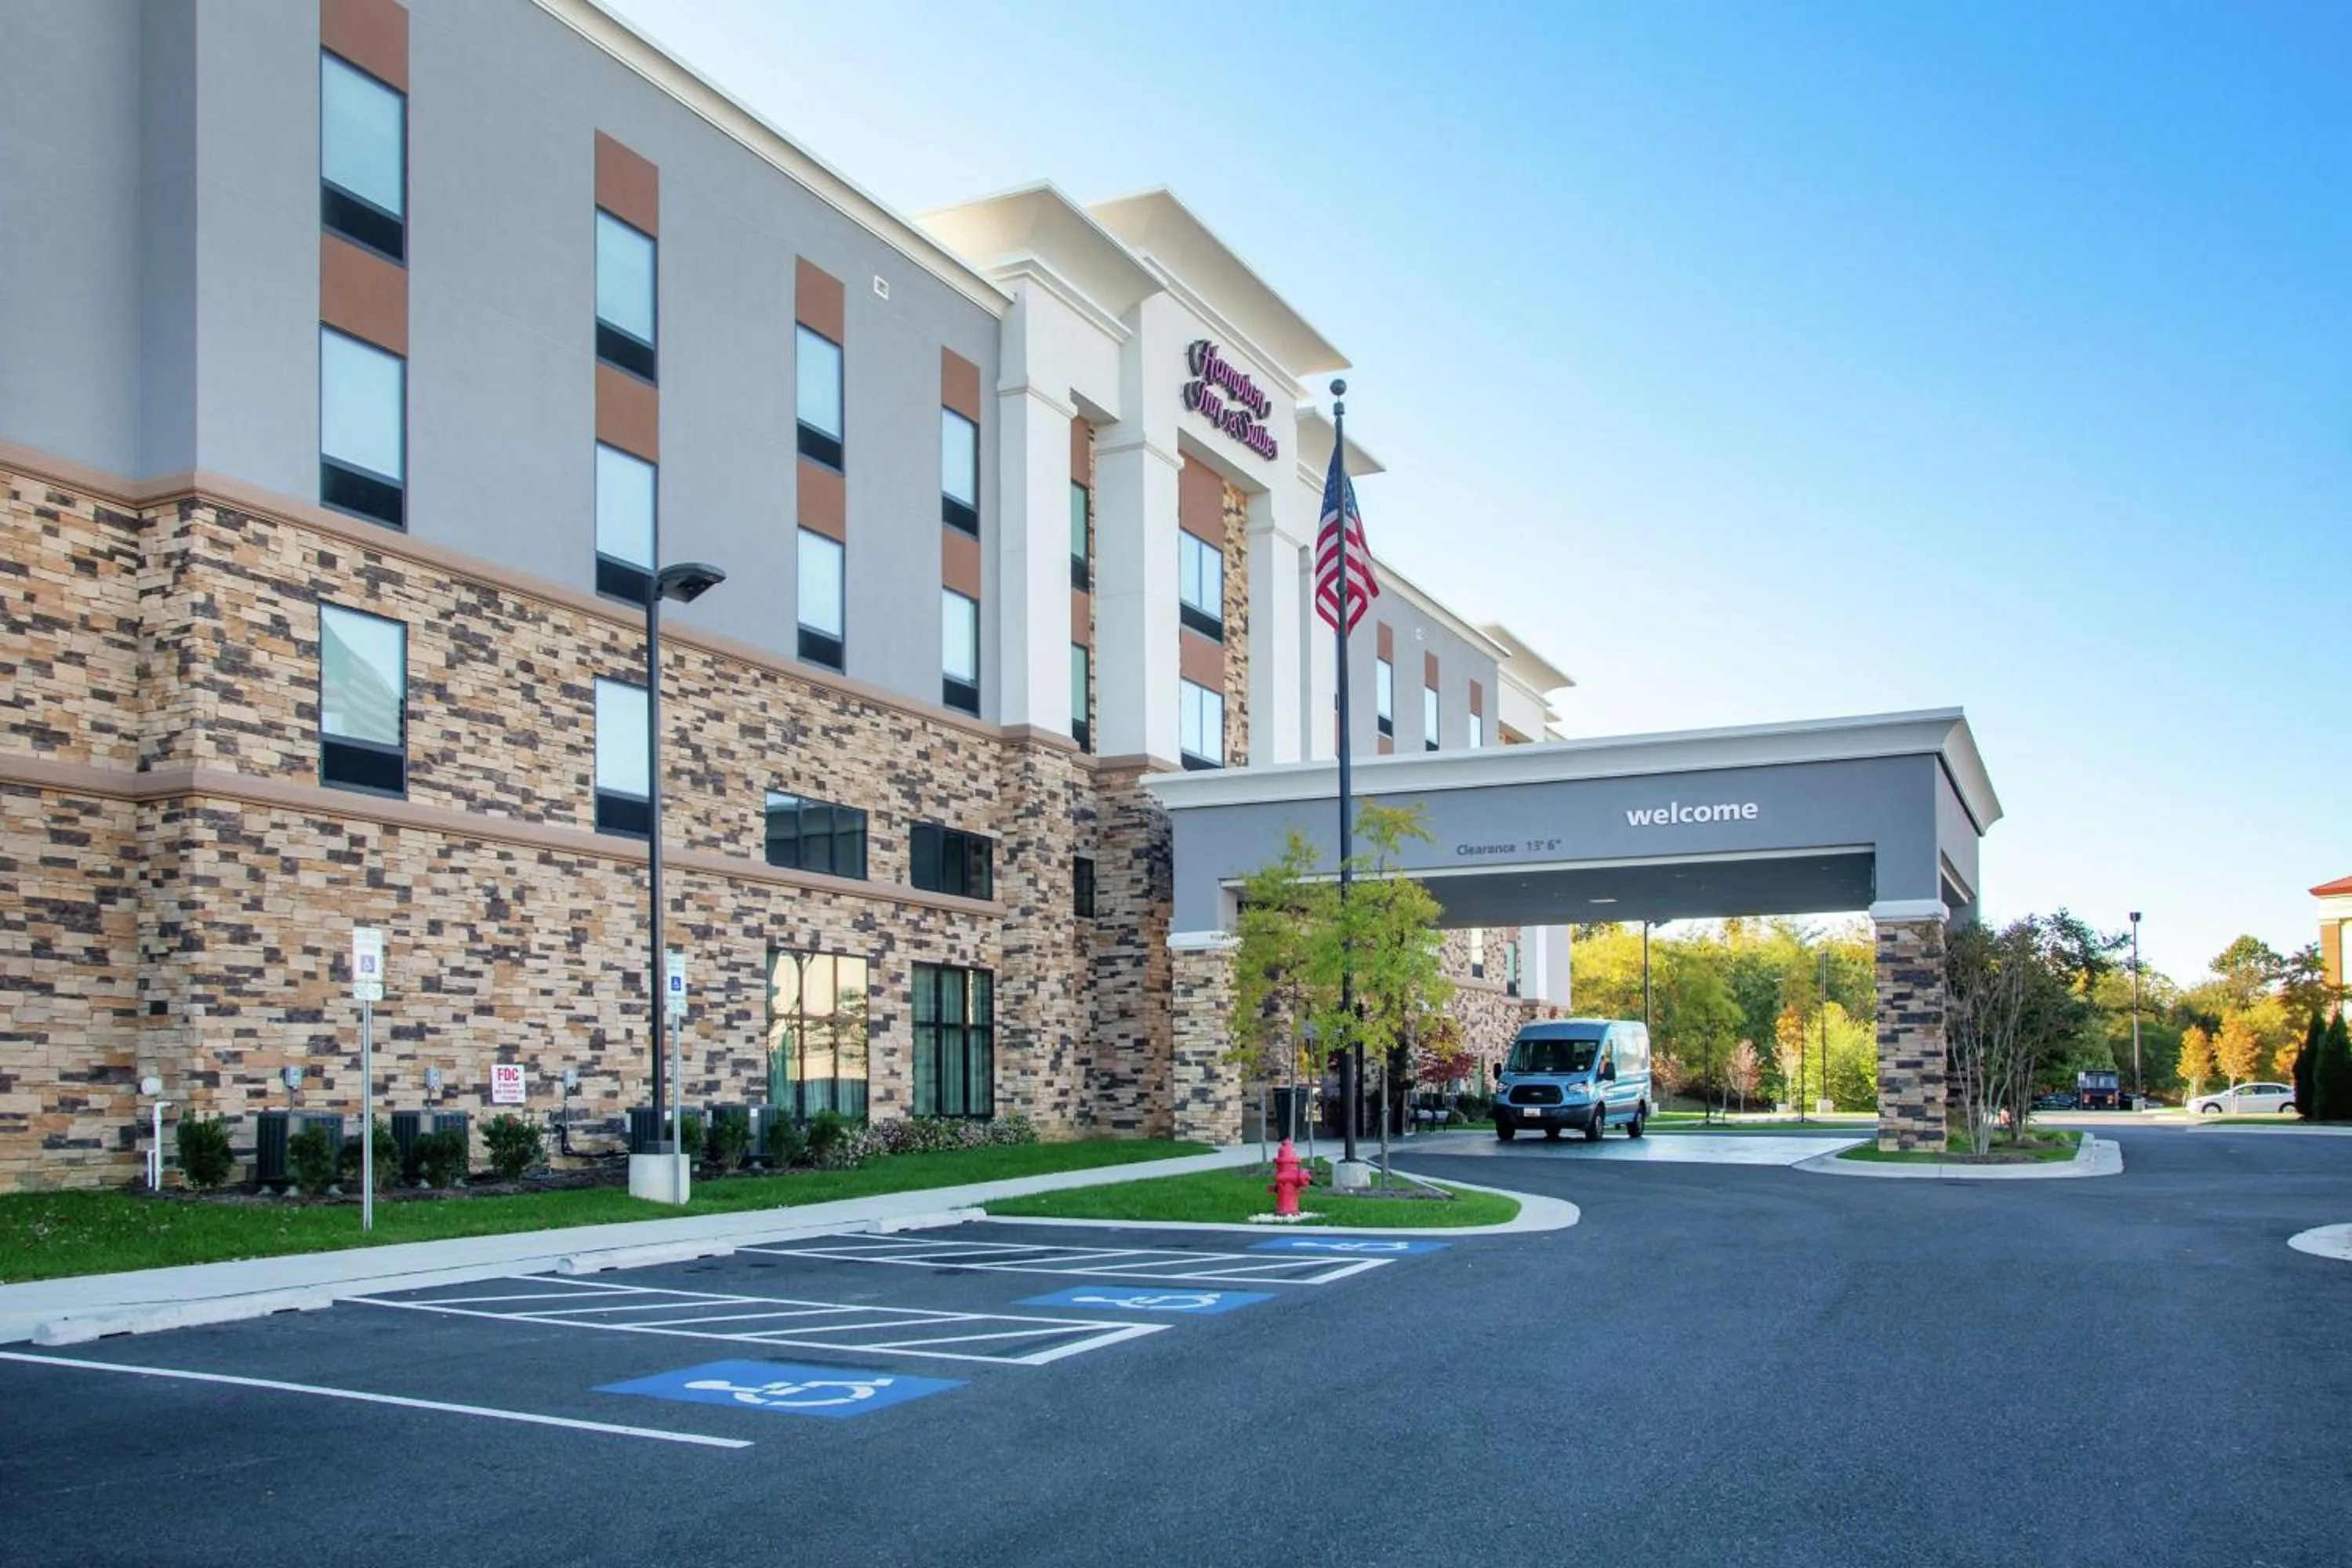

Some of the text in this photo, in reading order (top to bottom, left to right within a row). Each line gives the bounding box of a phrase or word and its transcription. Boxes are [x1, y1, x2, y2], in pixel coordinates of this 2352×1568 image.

[1189, 339, 1272, 419] Hampton
[1184, 380, 1229, 428] Inn
[1625, 800, 1759, 826] welcome
[1456, 844, 1516, 855] Clearance
[498, 1067, 519, 1081] FDC
